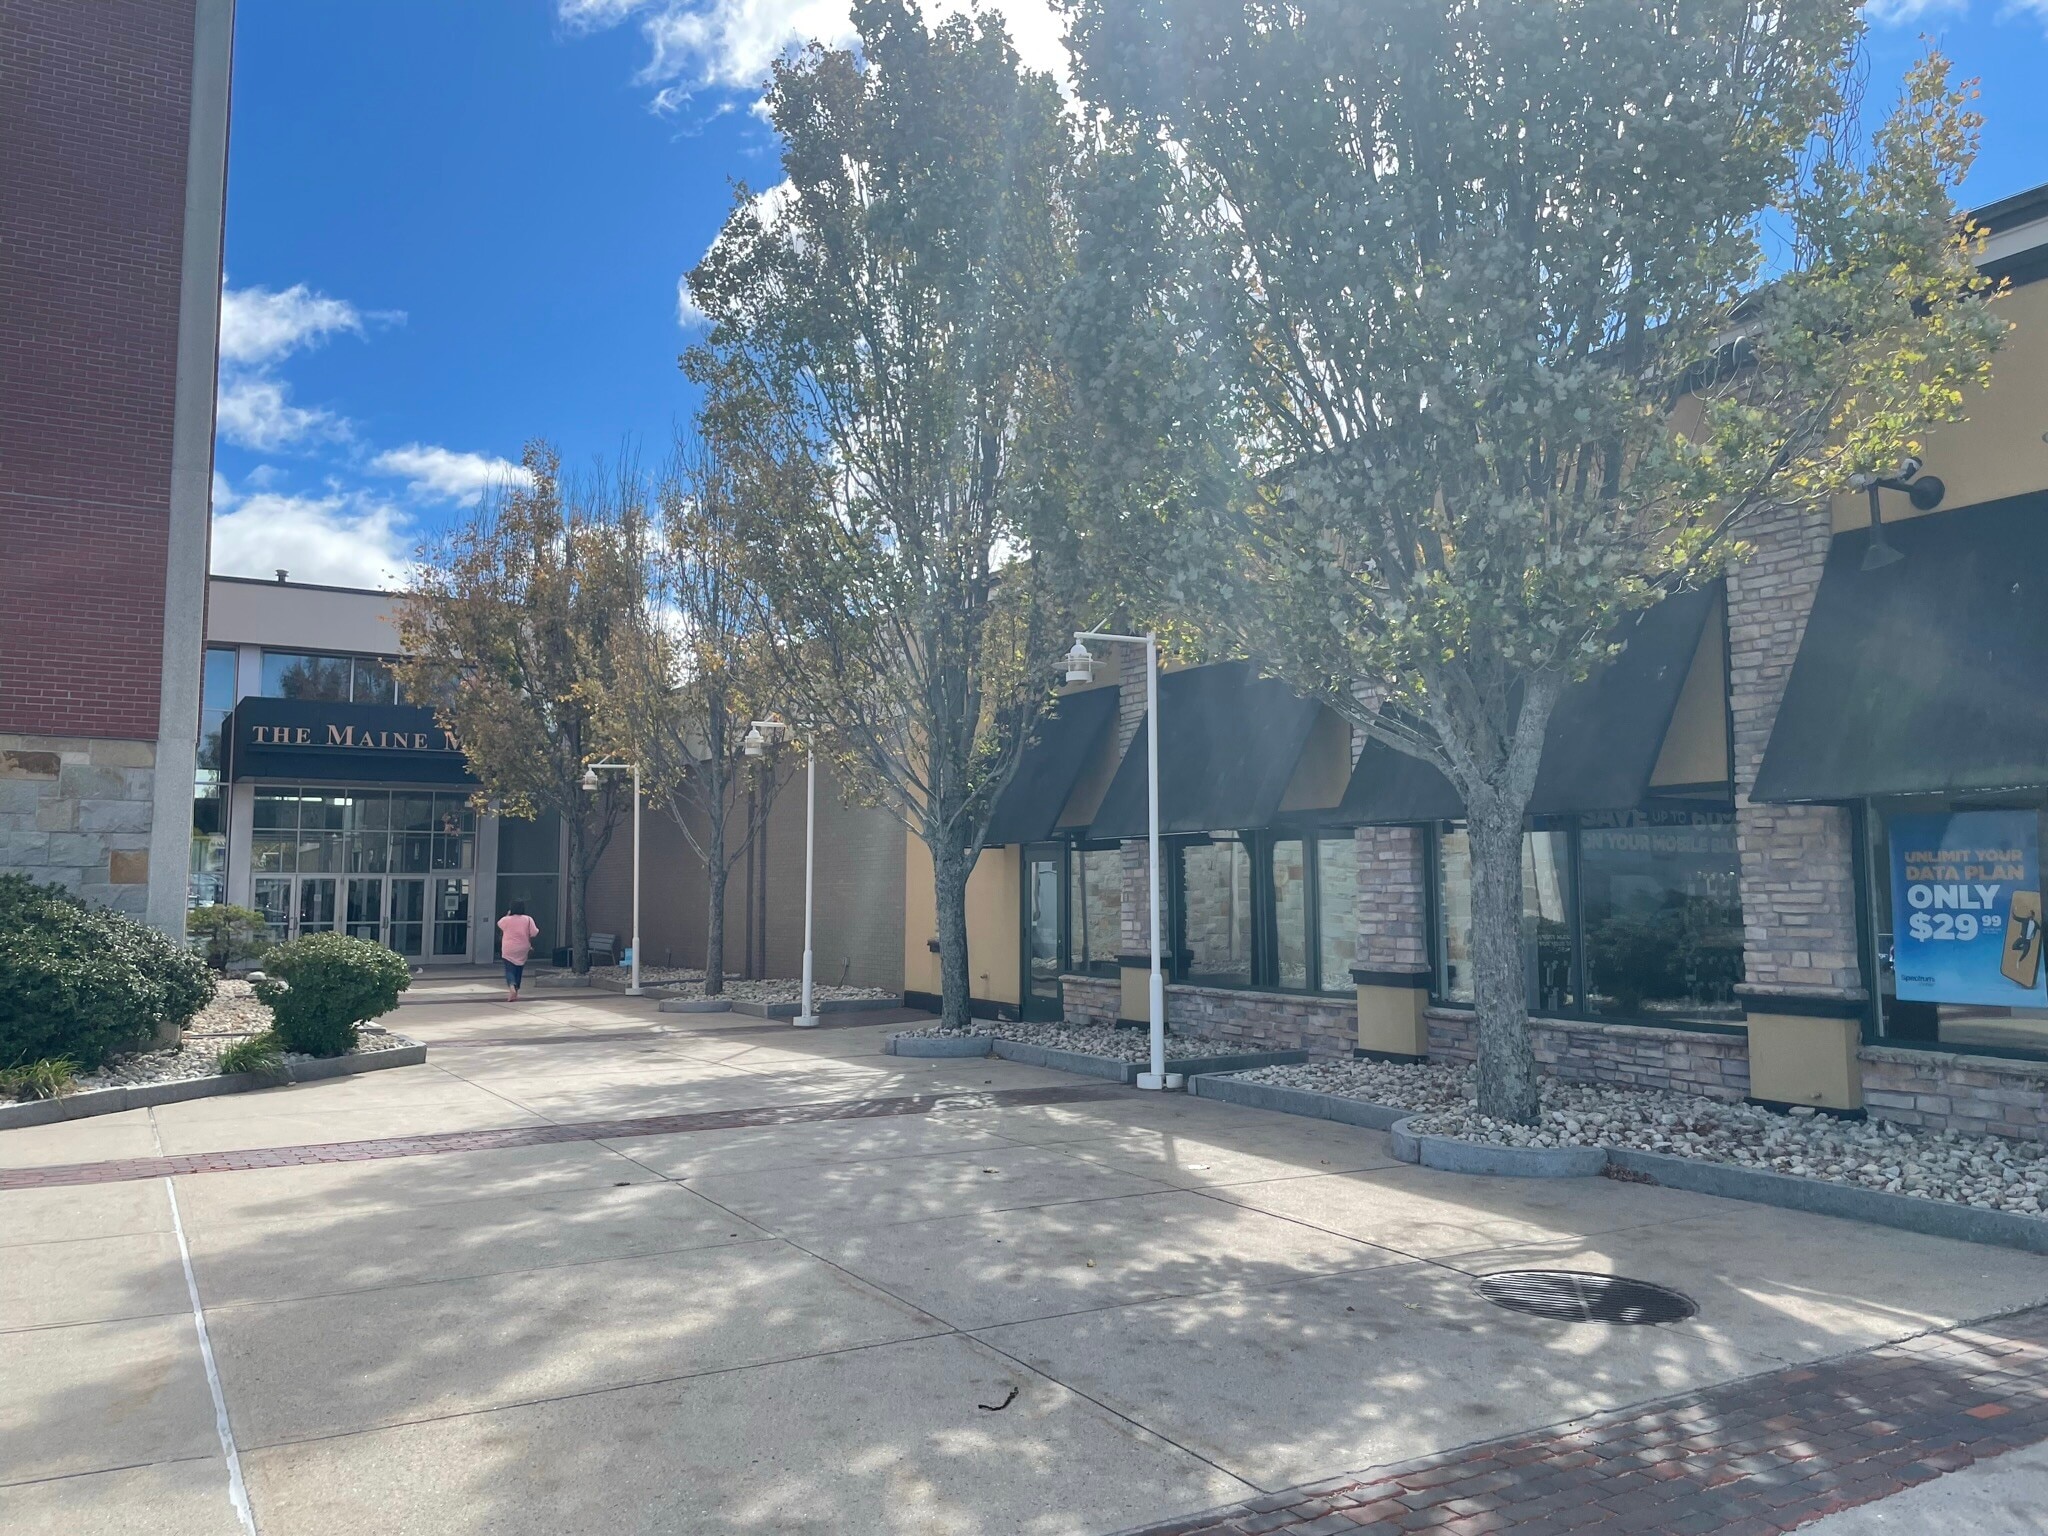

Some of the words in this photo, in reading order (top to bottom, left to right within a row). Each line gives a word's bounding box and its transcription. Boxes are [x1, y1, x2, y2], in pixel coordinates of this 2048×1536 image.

[252, 726, 312, 744] THE
[1652, 810, 1668, 823] UP
[1672, 811, 1687, 824] TO
[1605, 832, 1649, 850] YOUR
[1651, 834, 1708, 852] MOBILE
[1904, 849, 1972, 863] UNLIMIT
[1975, 849, 2023, 862] YOUR
[1905, 865, 1960, 880] DATA
[1964, 864, 2025, 880] PLAN
[1907, 884, 2001, 910] ONLY
